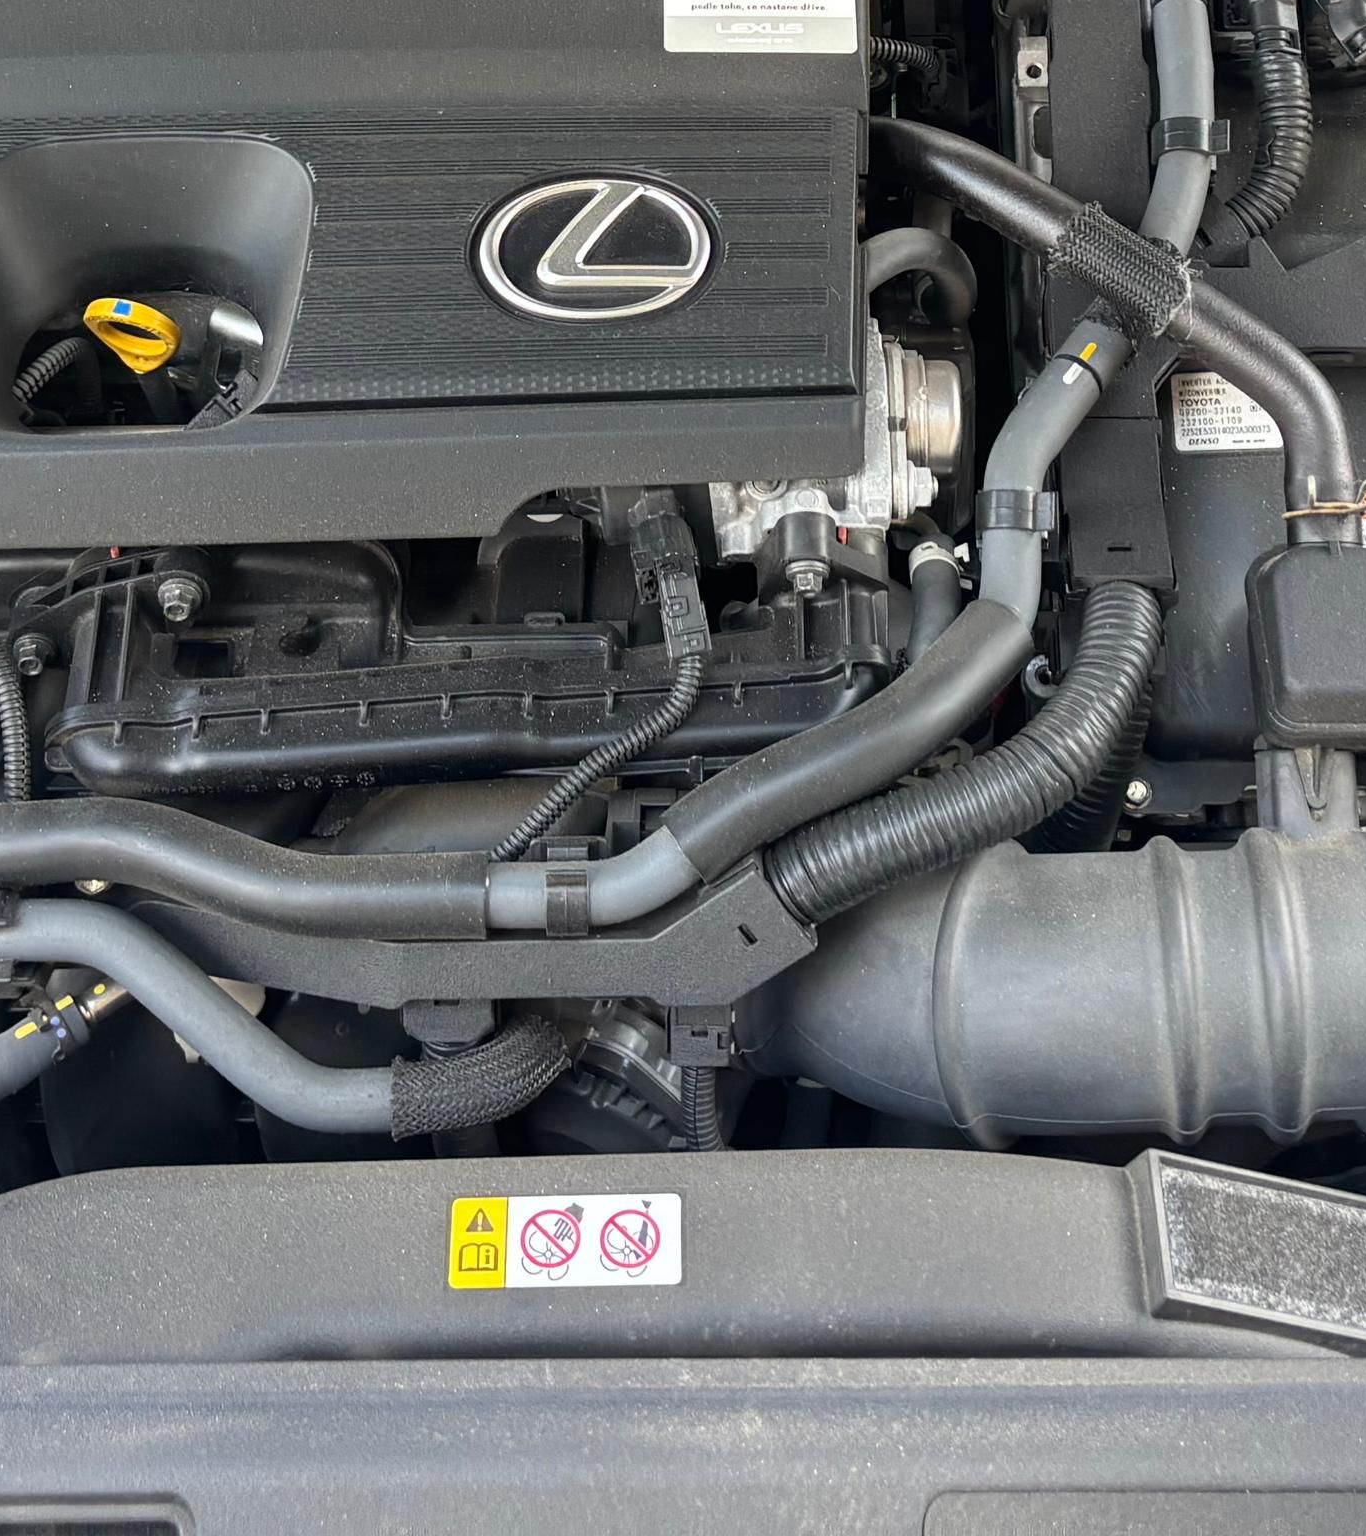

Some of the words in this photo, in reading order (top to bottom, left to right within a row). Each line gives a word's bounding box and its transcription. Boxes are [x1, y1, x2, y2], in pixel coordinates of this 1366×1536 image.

[715, 22, 805, 35] LEXUS
[1179, 398, 1222, 407] TOYOTA
[1188, 438, 1220, 446] DENSO
